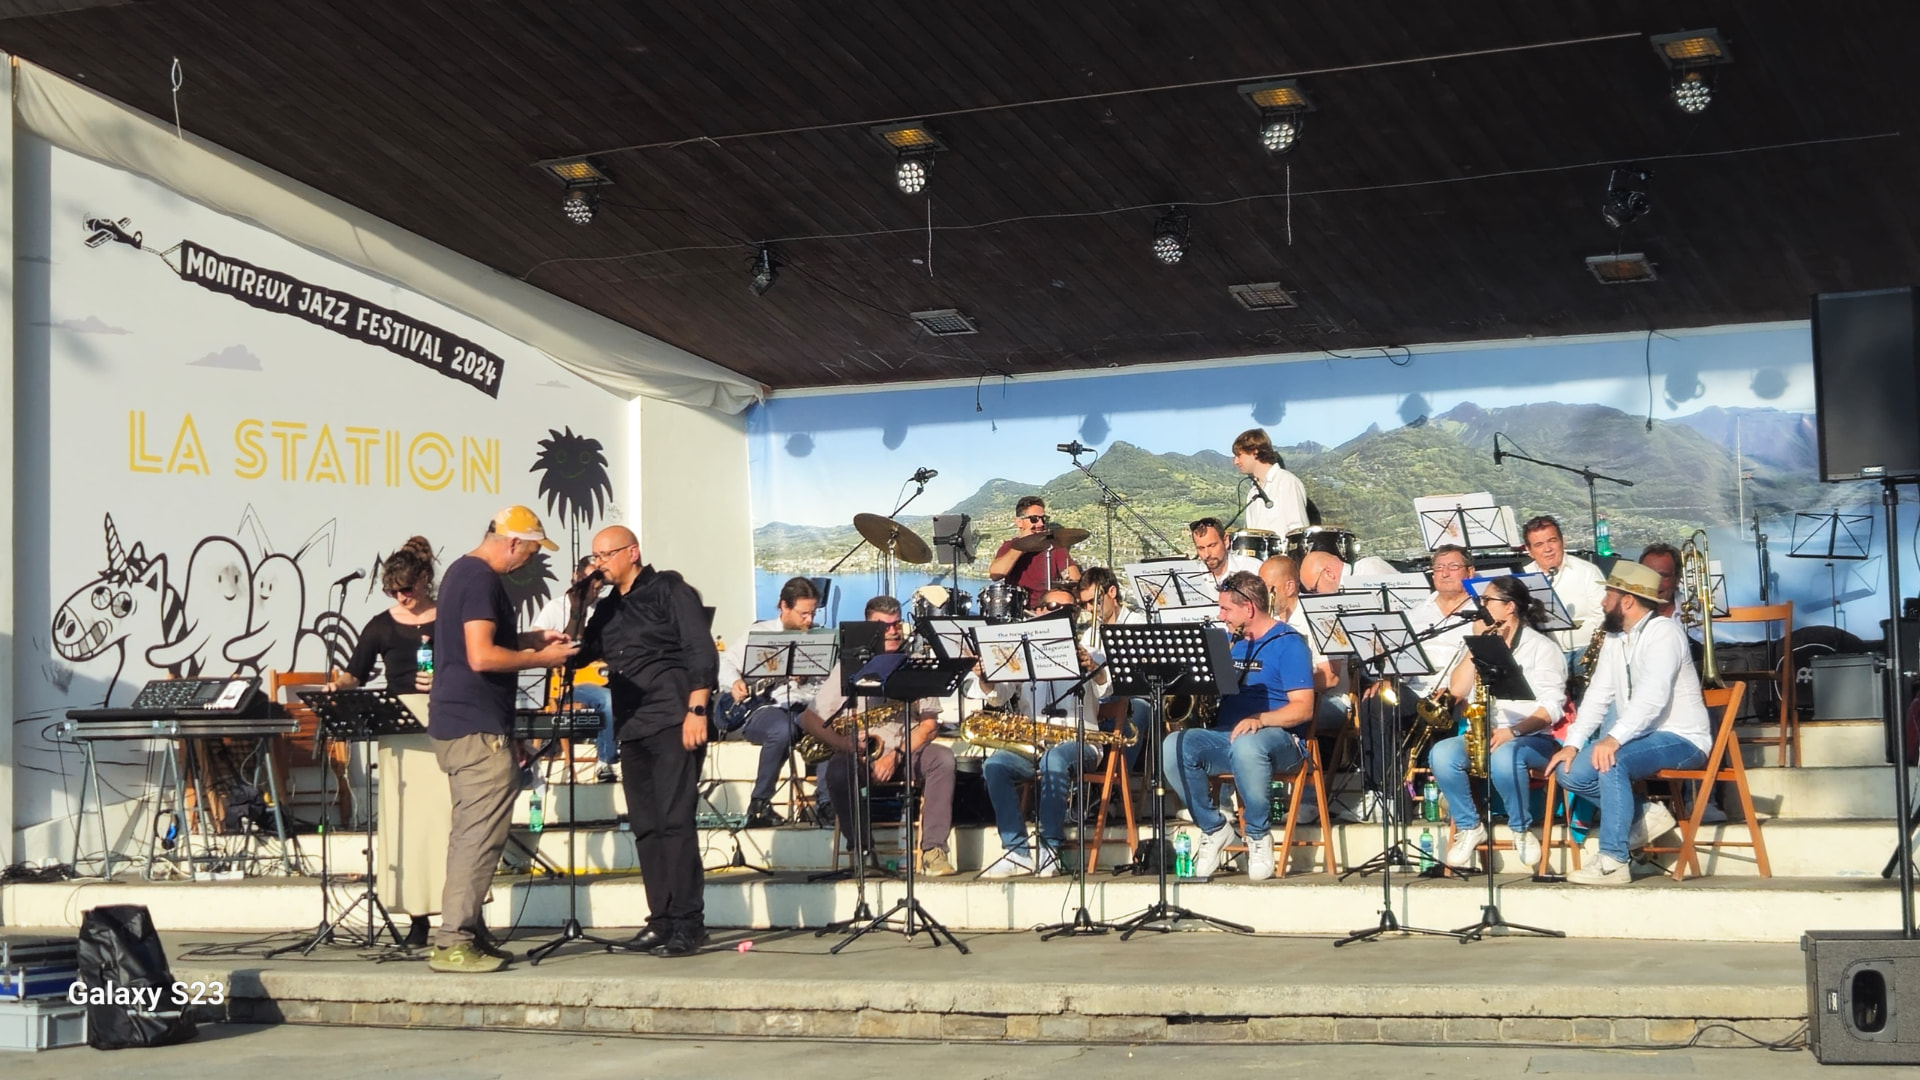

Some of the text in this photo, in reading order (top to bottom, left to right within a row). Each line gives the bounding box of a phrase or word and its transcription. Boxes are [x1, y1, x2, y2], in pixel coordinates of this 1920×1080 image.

[187, 247, 497, 386] MONTREUX JAZZ FESTIVAL 2024
[129, 410, 500, 495] LA STATION
